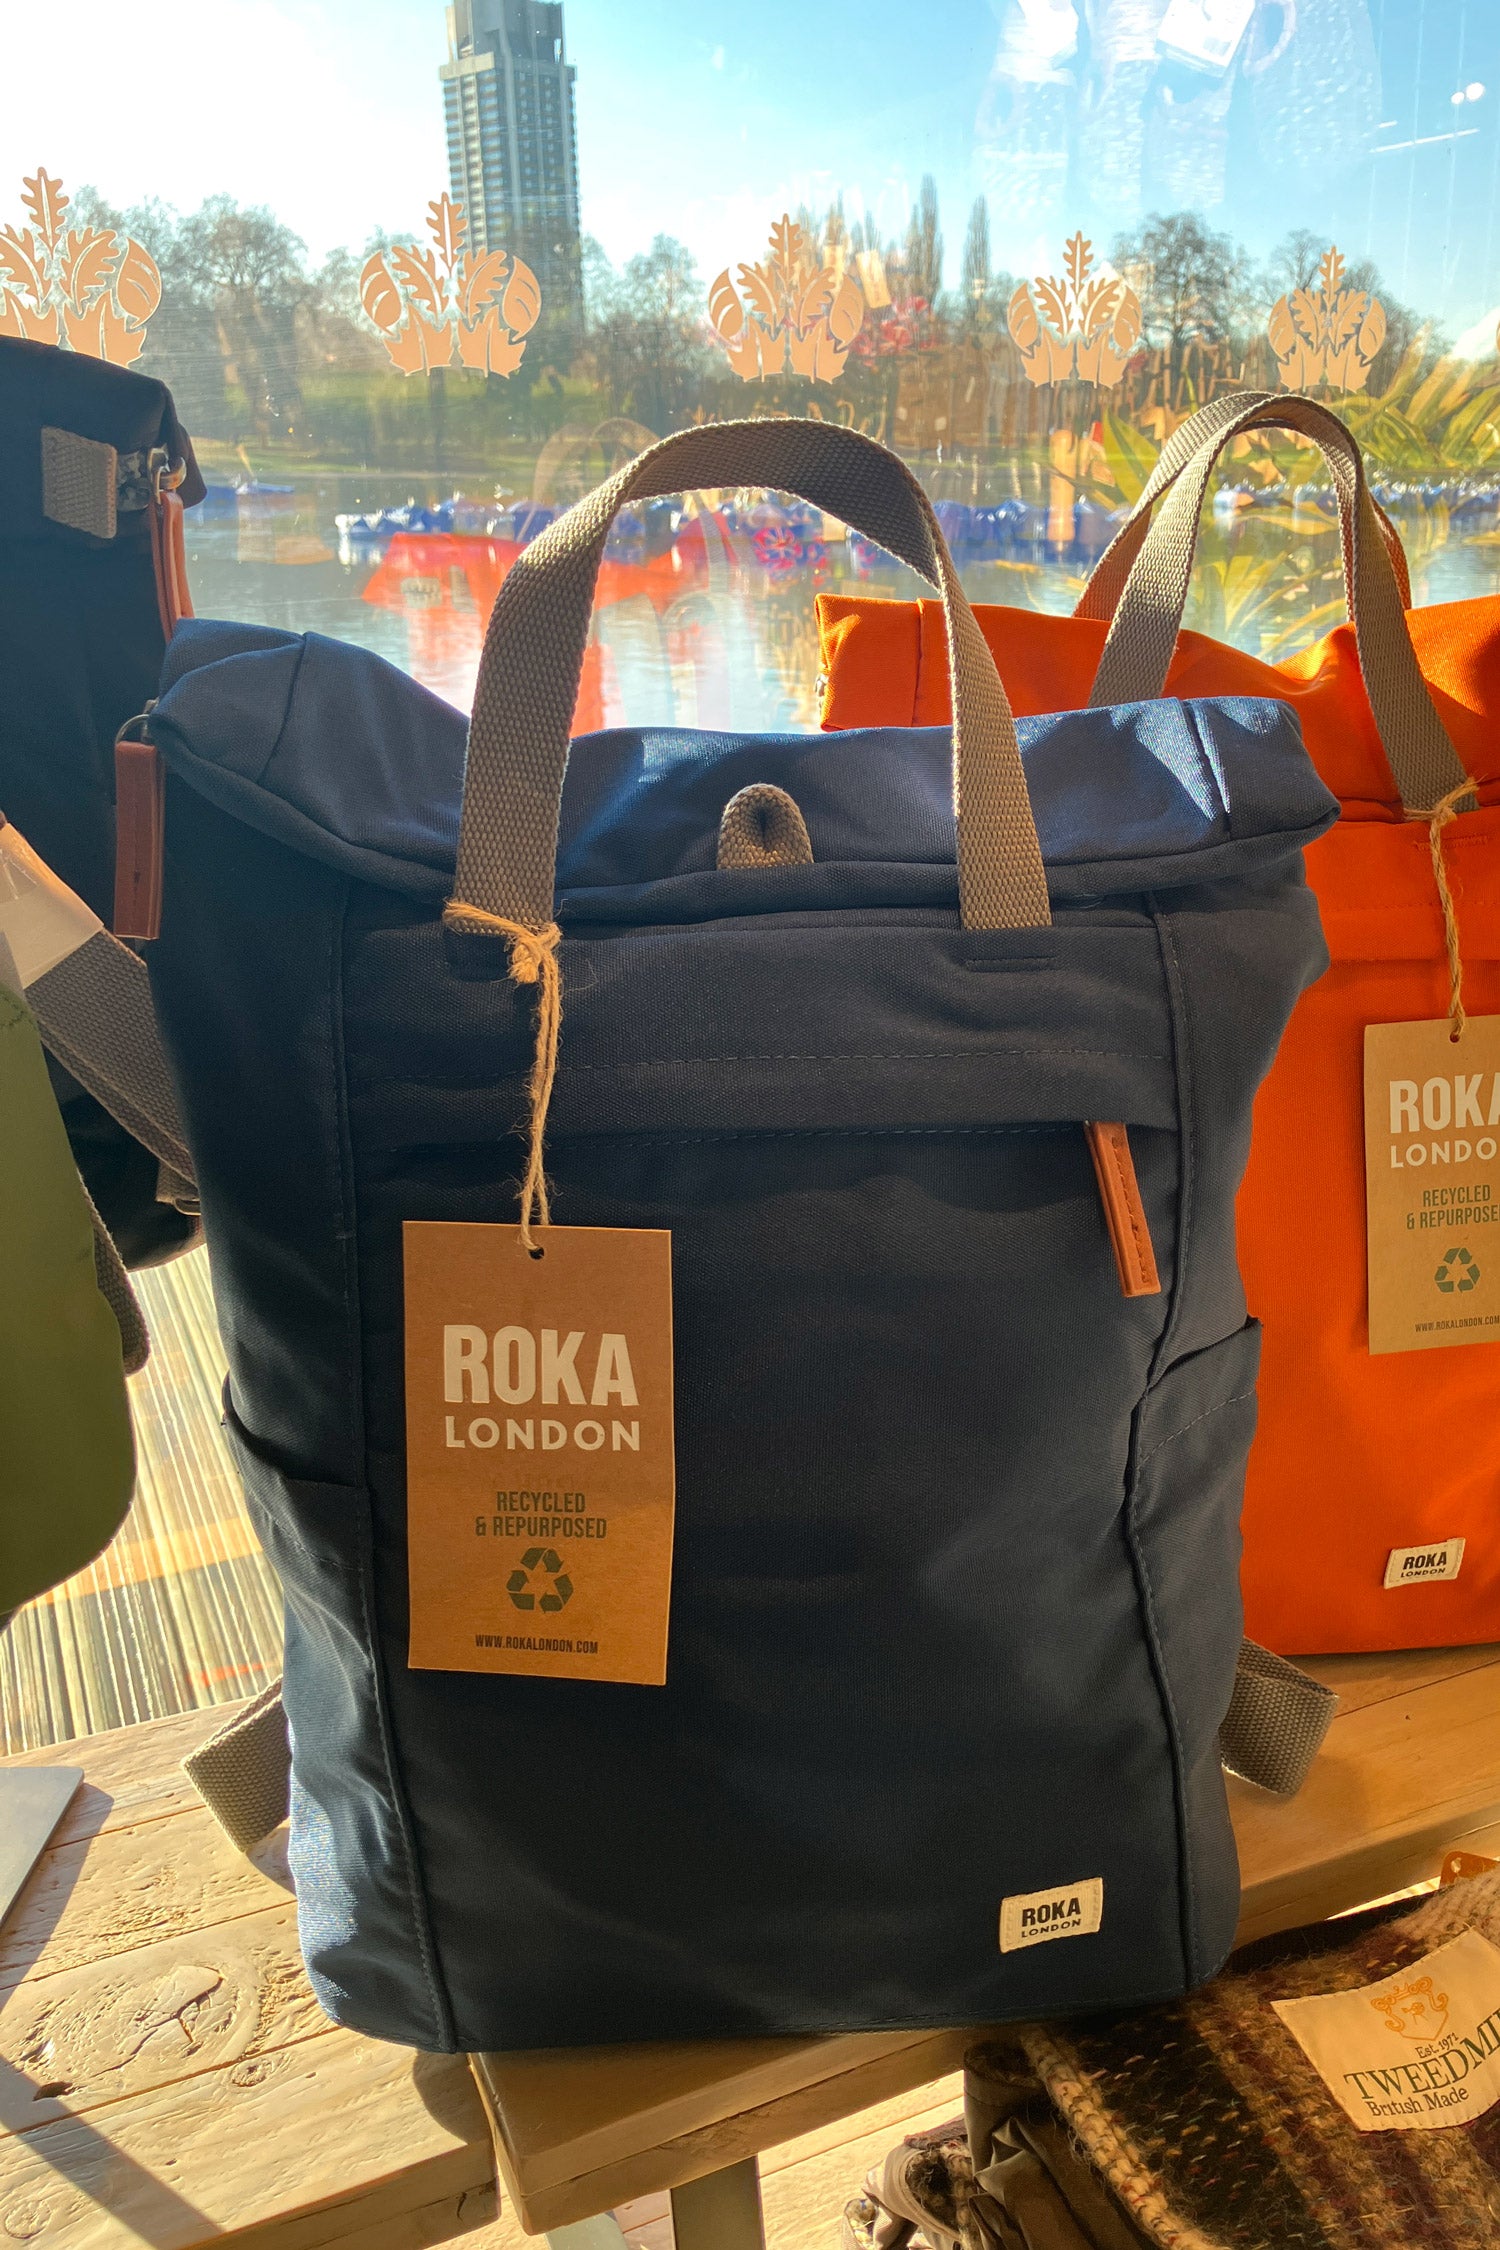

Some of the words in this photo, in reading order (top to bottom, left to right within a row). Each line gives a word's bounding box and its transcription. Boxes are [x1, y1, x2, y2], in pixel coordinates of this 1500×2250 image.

[1390, 1137, 1498, 1168] LONDO
[1423, 1185, 1490, 1207] RECYCLED
[1407, 1213, 1415, 1229] &
[1420, 1205, 1500, 1228] REPURPOSE
[1415, 1315, 1500, 1332] WWW.ROKALONDON.COM
[444, 1325, 640, 1406] ROKA
[445, 1415, 640, 1451] LONDON
[496, 1491, 586, 1513] RECYCLED
[475, 1516, 487, 1536] &
[493, 1516, 607, 1539] REPURPOSED
[1403, 1551, 1447, 1570] ROKA
[1400, 1568, 1446, 1578] LONDON
[475, 1634, 598, 1654] WWW.ROKALONDON.COM
[1022, 1897, 1081, 1927] ROKA
[1021, 1918, 1082, 1938] LONDON
[1344, 2008, 1500, 2100] TWEEDMI
[1415, 2044, 1439, 2059] Est.
[1438, 2032, 1459, 2051] 1971
[1365, 2097, 1424, 2117] British
[1423, 2086, 1469, 2111] Made
